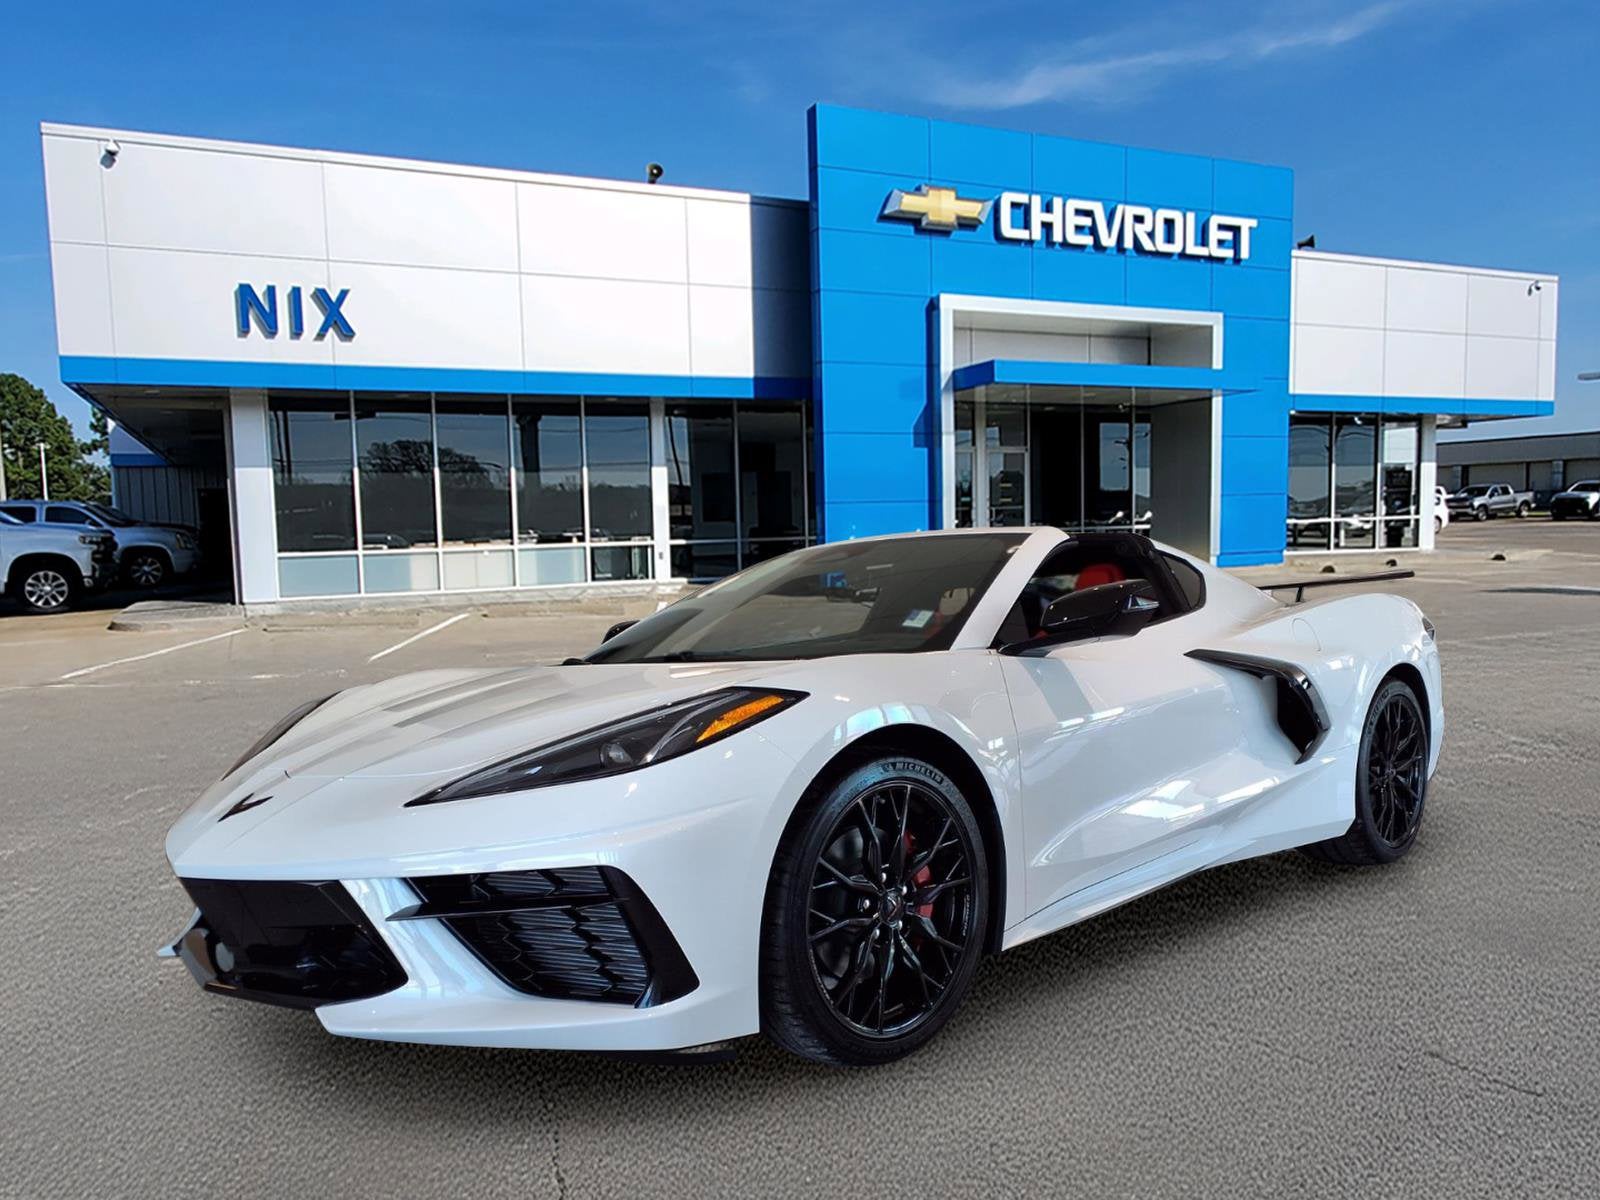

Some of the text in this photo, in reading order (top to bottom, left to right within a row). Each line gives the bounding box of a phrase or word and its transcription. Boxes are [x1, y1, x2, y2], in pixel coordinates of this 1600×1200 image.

[1000, 191, 1258, 260] CHEVROLET
[235, 283, 356, 341] NIX
[895, 761, 943, 783] MICHELIN
